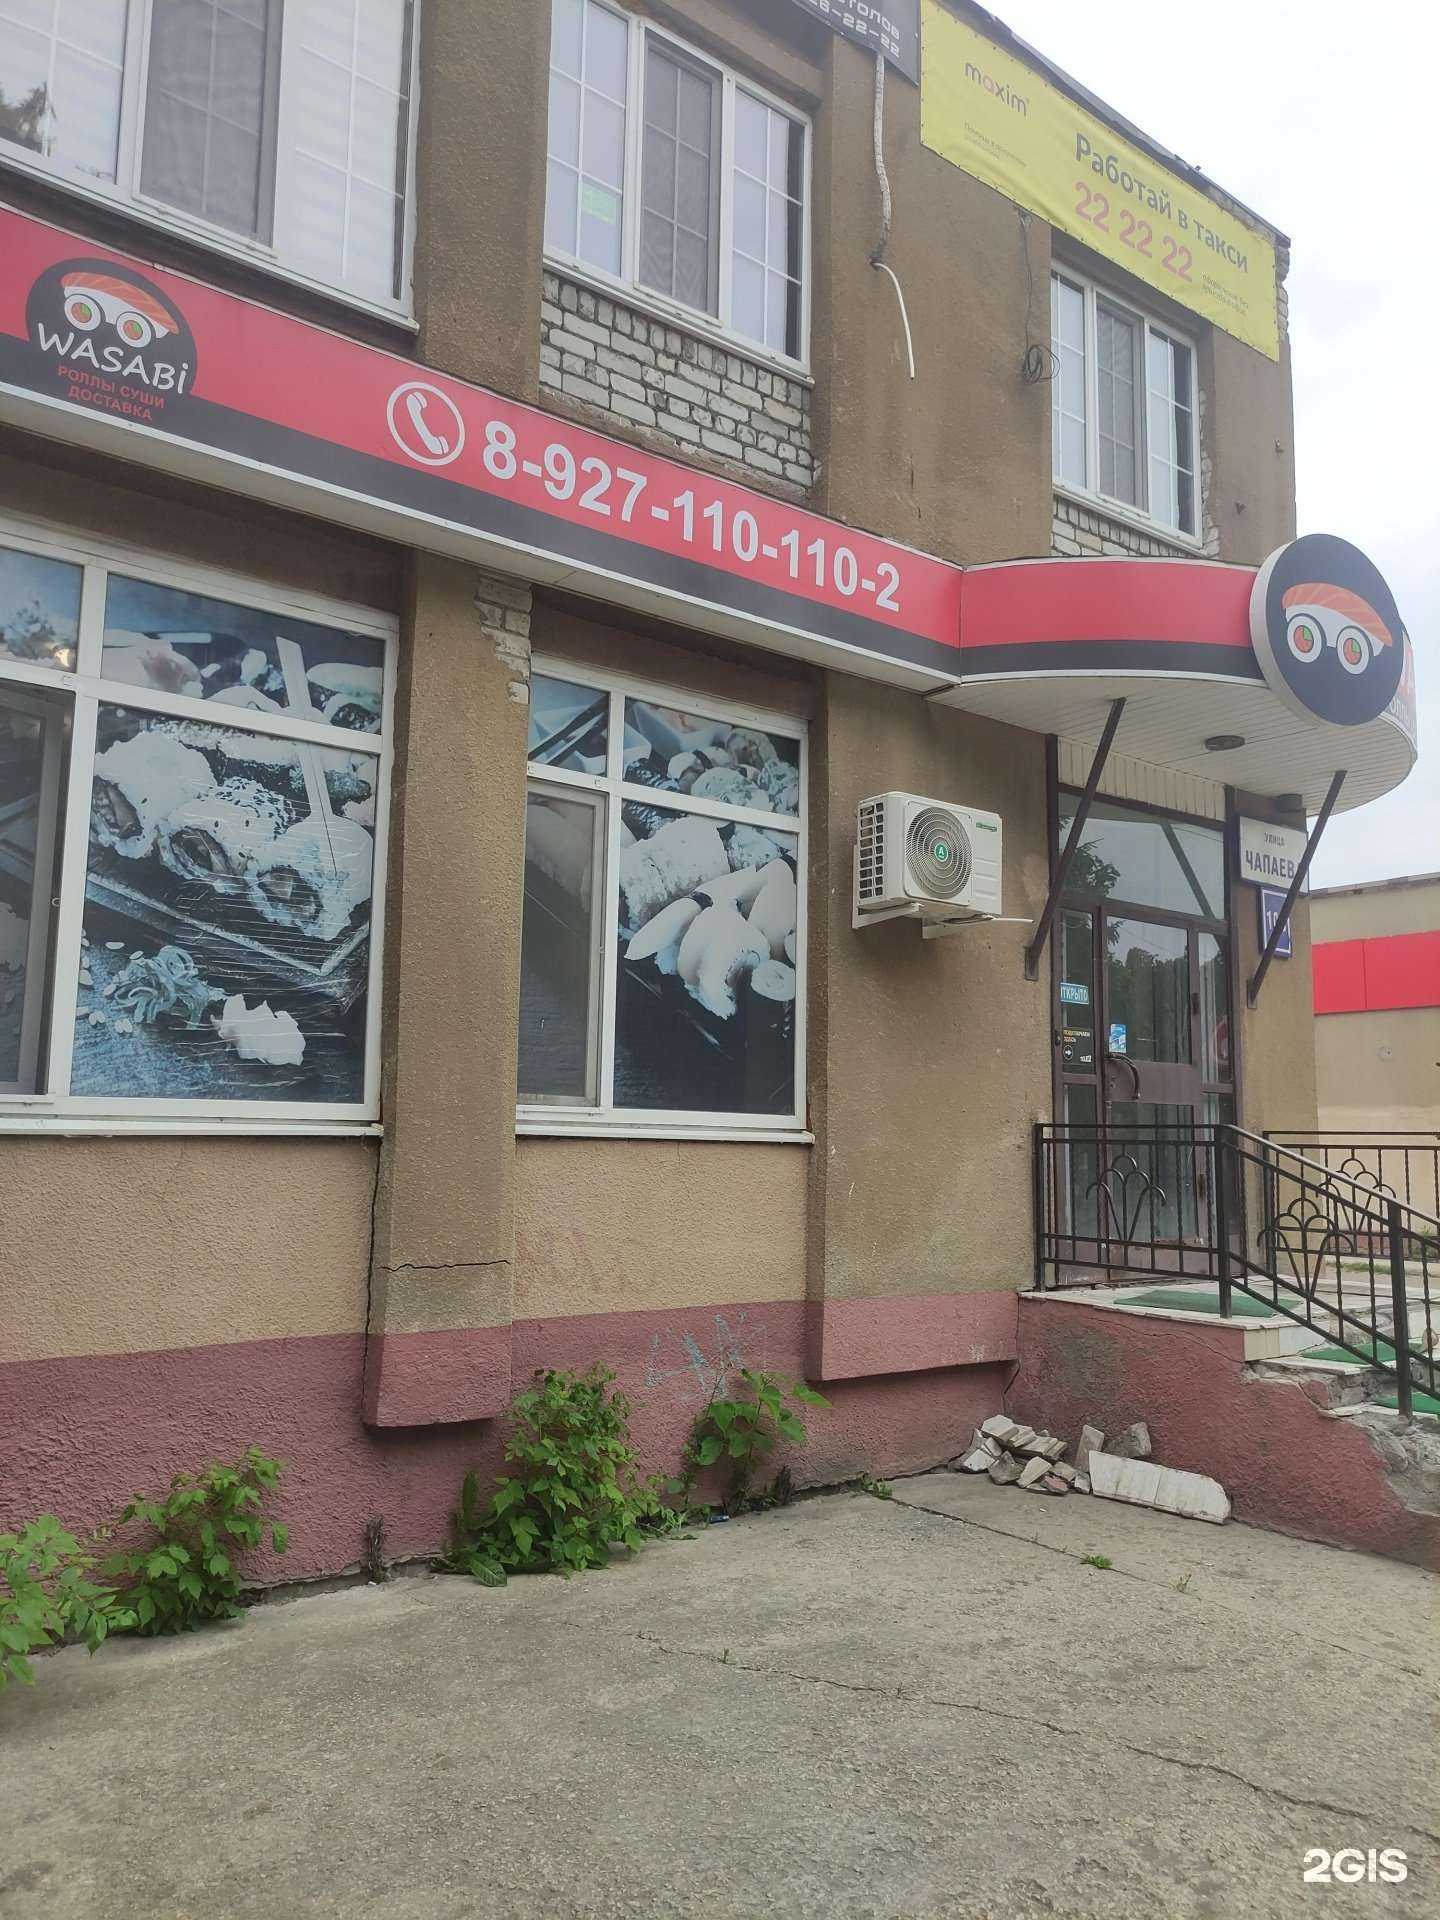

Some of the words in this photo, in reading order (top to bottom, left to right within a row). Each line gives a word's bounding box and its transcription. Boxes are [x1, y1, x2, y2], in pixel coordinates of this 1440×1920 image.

[965, 62, 1027, 117] maxim
[1075, 133, 1172, 220] Работай
[1178, 209, 1189, 230] в
[1193, 219, 1248, 273] такси
[1075, 181, 1110, 233] 22
[1119, 209, 1153, 258] 22
[1161, 235, 1193, 283] 22
[58, 365, 116, 394] РОЛЛЫ
[119, 387, 165, 409] СУШИ
[68, 385, 153, 421] ДОСТАВКА
[482, 420, 901, 612] 8-927-110-110-2
[1245, 849, 1301, 880] ЧАПАЕВ
